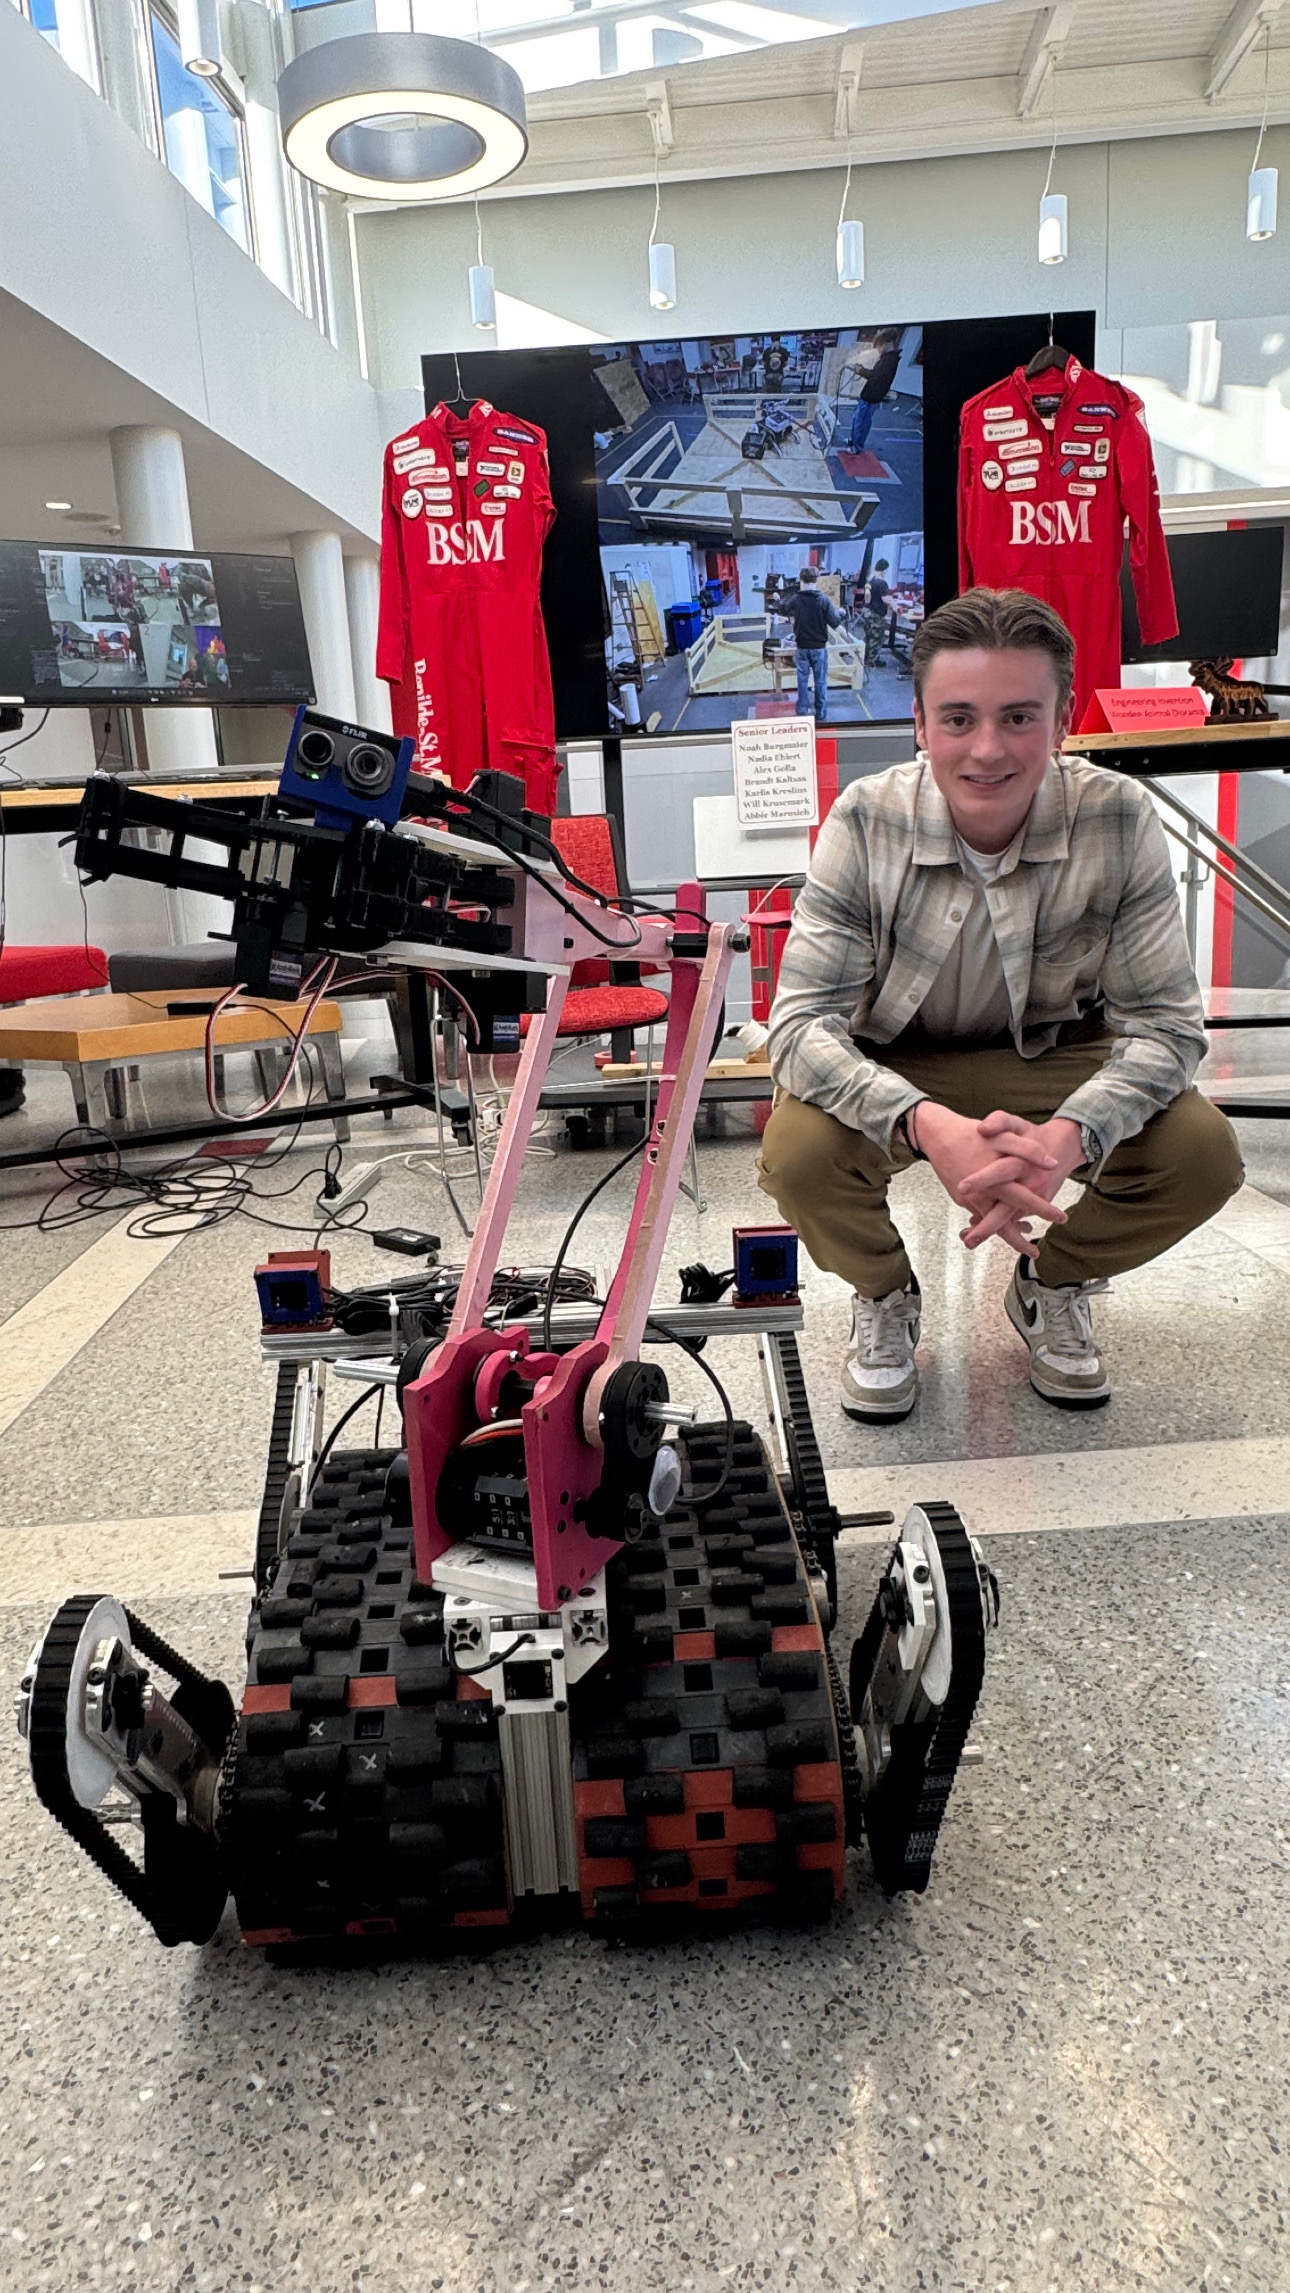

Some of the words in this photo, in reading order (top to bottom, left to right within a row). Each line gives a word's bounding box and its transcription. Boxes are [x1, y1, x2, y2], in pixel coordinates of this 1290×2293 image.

[1008, 500, 1093, 545] BSM
[425, 518, 506, 566] BSM
[738, 728, 769, 737] Senior
[771, 725, 808, 735] Leaders
[739, 743, 761, 752] Noah
[743, 799, 761, 808] Will
